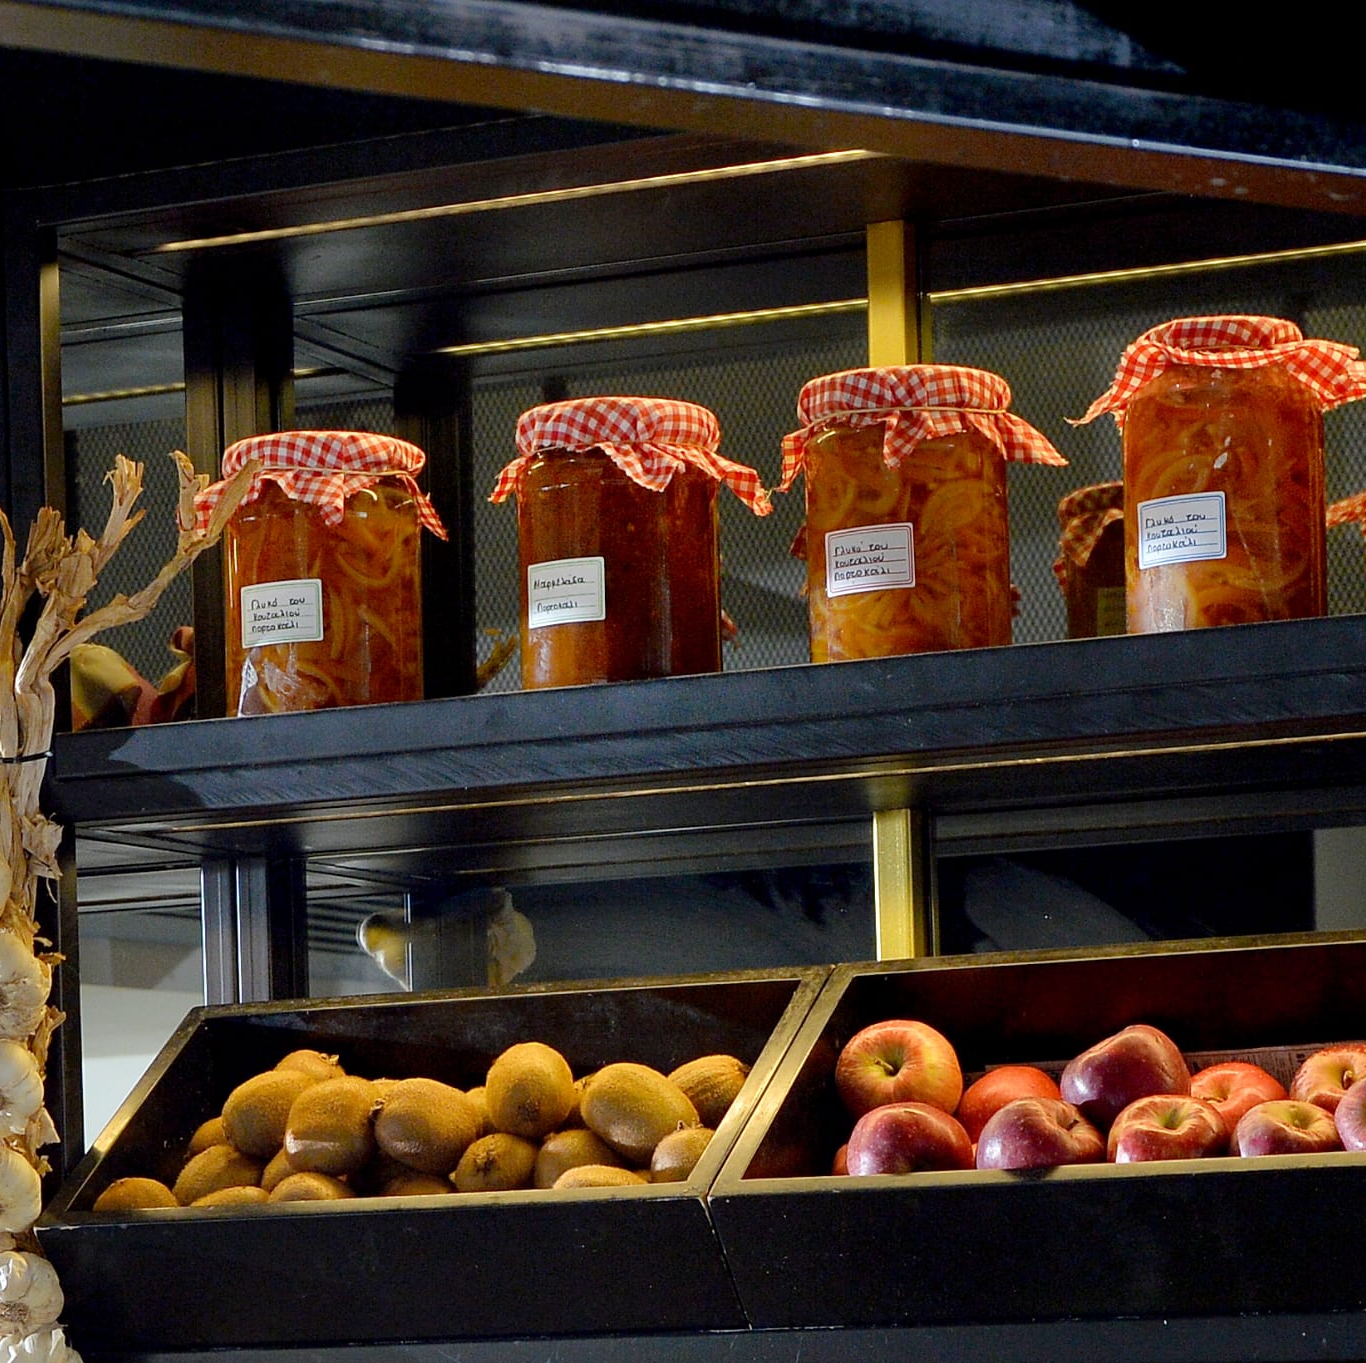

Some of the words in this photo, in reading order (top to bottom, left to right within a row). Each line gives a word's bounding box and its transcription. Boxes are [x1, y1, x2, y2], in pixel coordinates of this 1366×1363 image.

[1146, 515, 1174, 529] Γλυκό
[1186, 513, 1205, 521] του
[834, 541, 863, 557] Γλυκό
[868, 543, 888, 551] του
[251, 598, 278, 611] Γλυκό
[289, 597, 305, 605] του
